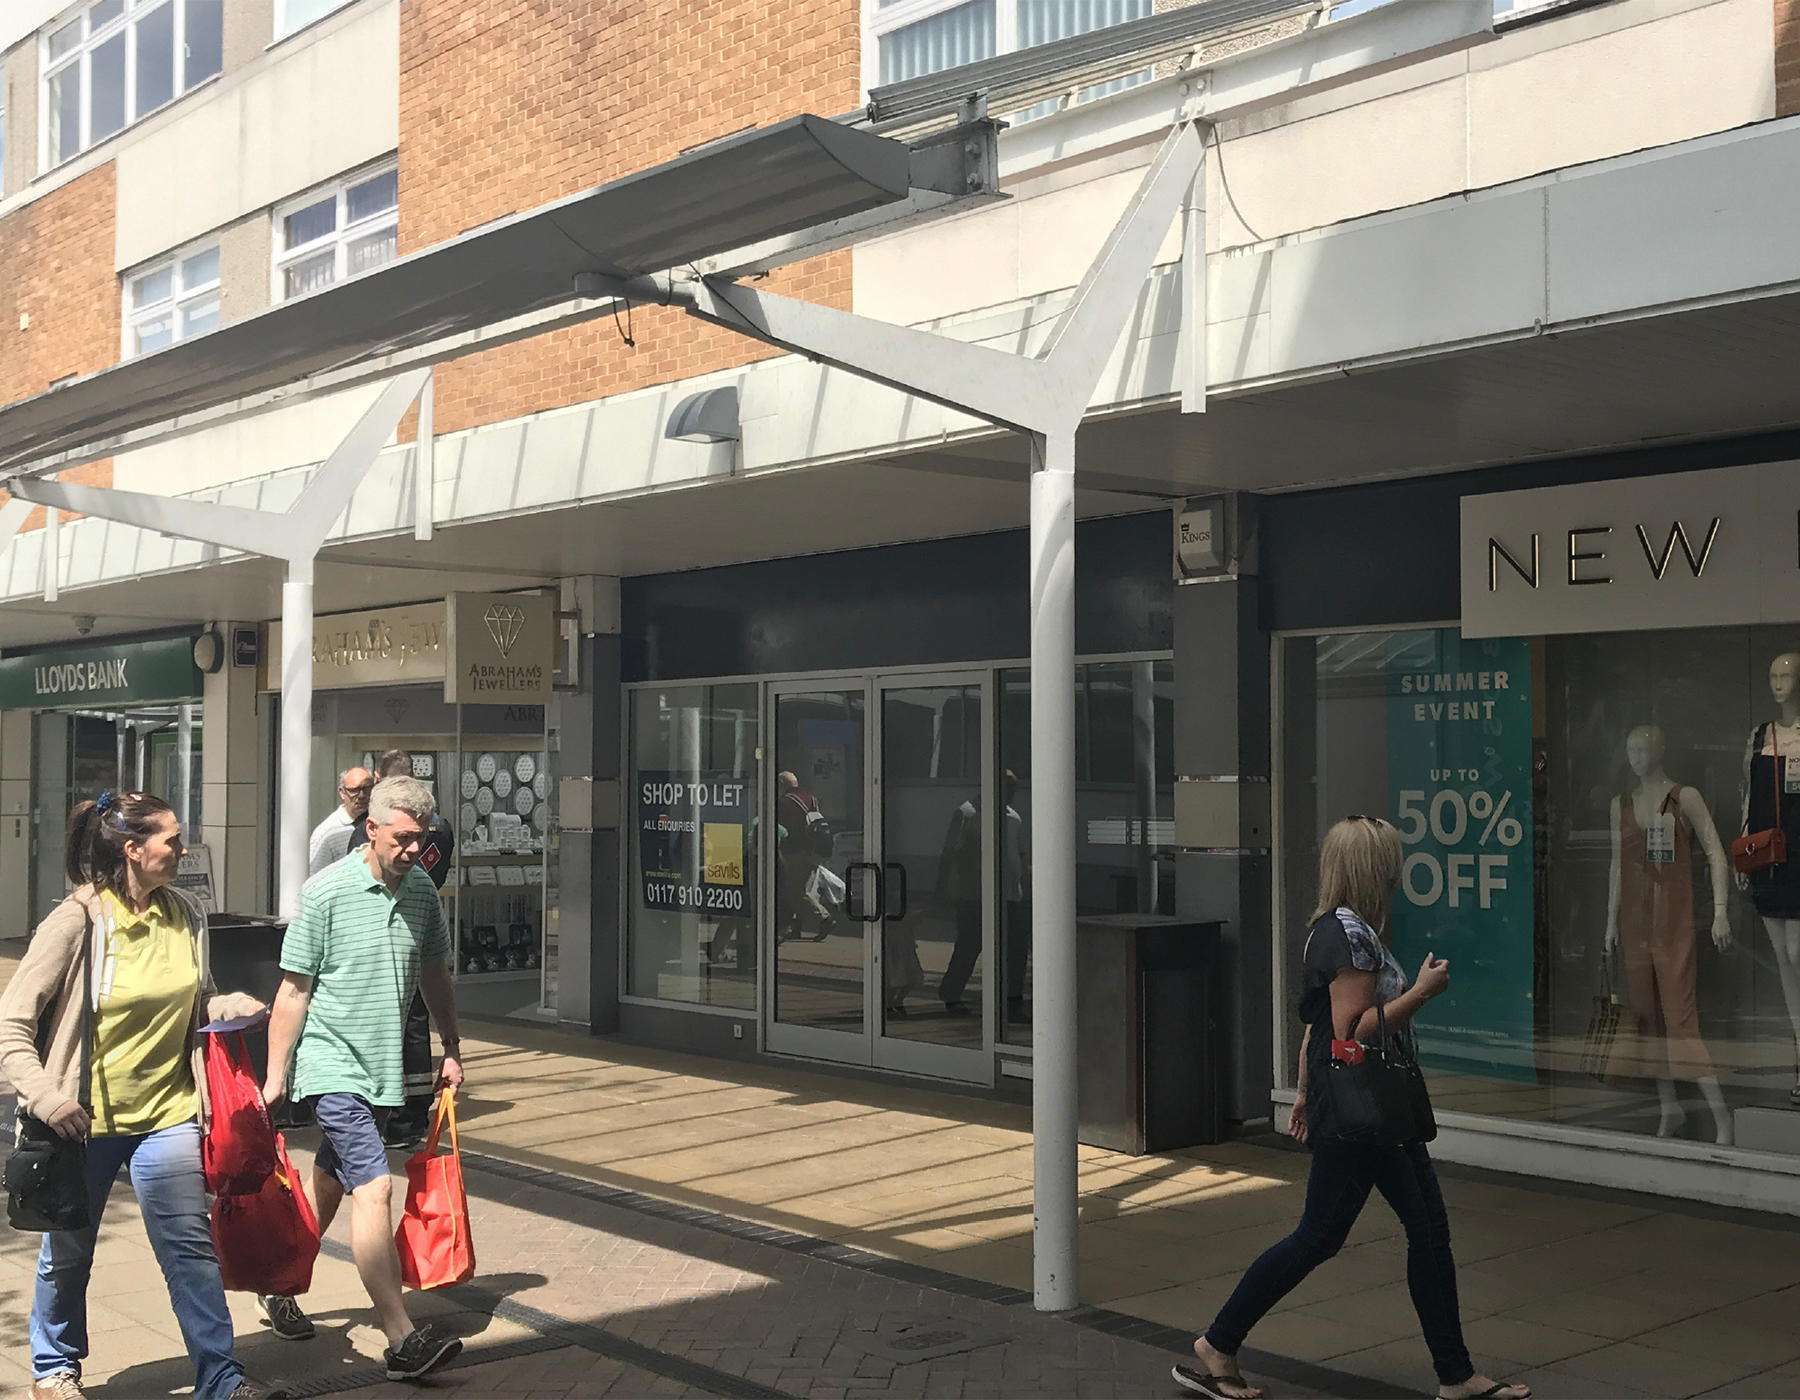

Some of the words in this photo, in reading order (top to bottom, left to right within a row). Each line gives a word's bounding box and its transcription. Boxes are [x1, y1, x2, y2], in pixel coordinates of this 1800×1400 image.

[1181, 531, 1210, 544] KINGS
[1489, 516, 1720, 591] NEW
[35, 663, 86, 694] LLOYDS
[87, 658, 129, 690] BANK
[468, 664, 543, 678] ABRAHAM'S
[1401, 671, 1509, 693] SUMMER
[1414, 701, 1495, 721] EVENT
[1430, 769, 1452, 781] UP
[1458, 769, 1480, 781] TO
[643, 783, 683, 805] SHOP
[687, 784, 708, 806] TO
[713, 784, 743, 806] LET
[643, 820, 656, 830] ALL
[657, 820, 695, 832] ENQUIRIES
[1398, 789, 1523, 847] 50%
[707, 862, 740, 879] savills
[1402, 852, 1509, 909] OFF
[647, 883, 675, 903] 0117
[678, 886, 703, 906] 910
[707, 888, 742, 910] 2200
